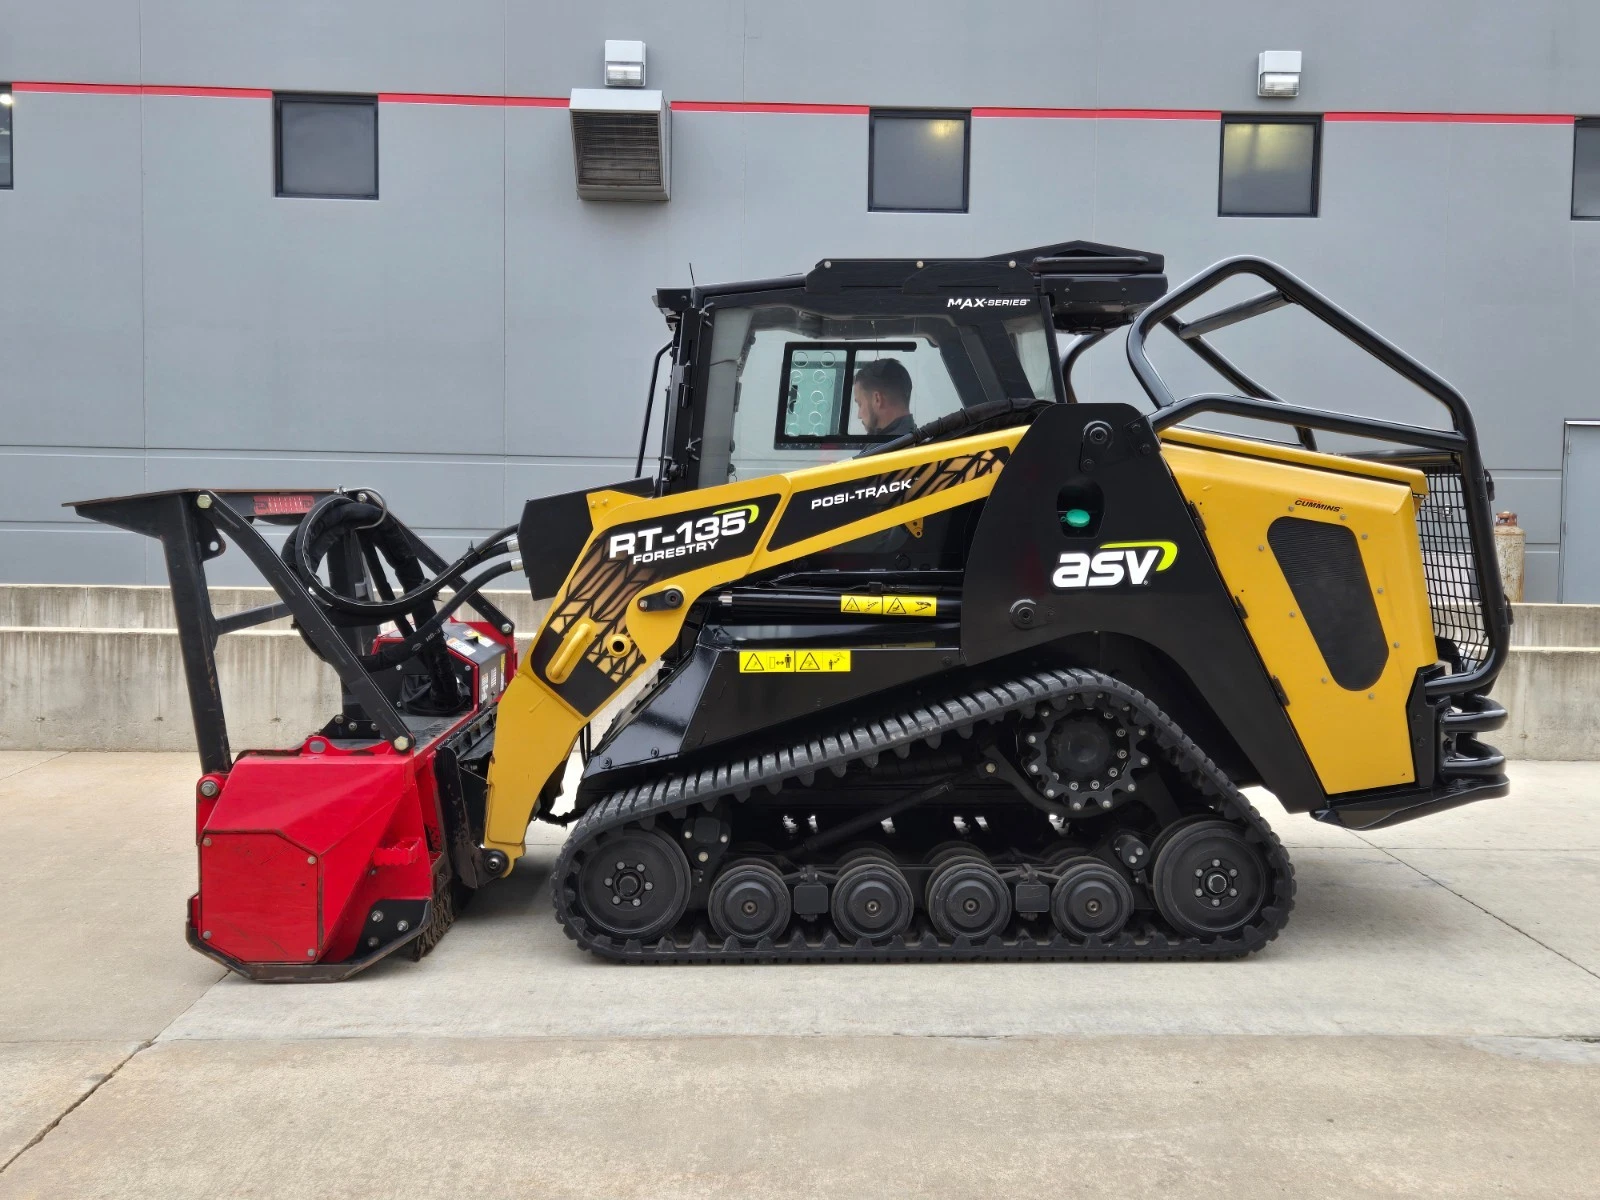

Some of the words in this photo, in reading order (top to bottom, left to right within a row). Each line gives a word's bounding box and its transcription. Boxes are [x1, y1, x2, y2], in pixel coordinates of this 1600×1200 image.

[947, 298, 1028, 309] MAX-SERIES
[811, 479, 912, 510] POSI-TRACK
[1294, 499, 1342, 513] CUMMINS
[609, 511, 746, 559] RT-135
[633, 540, 719, 565] FORESTRY
